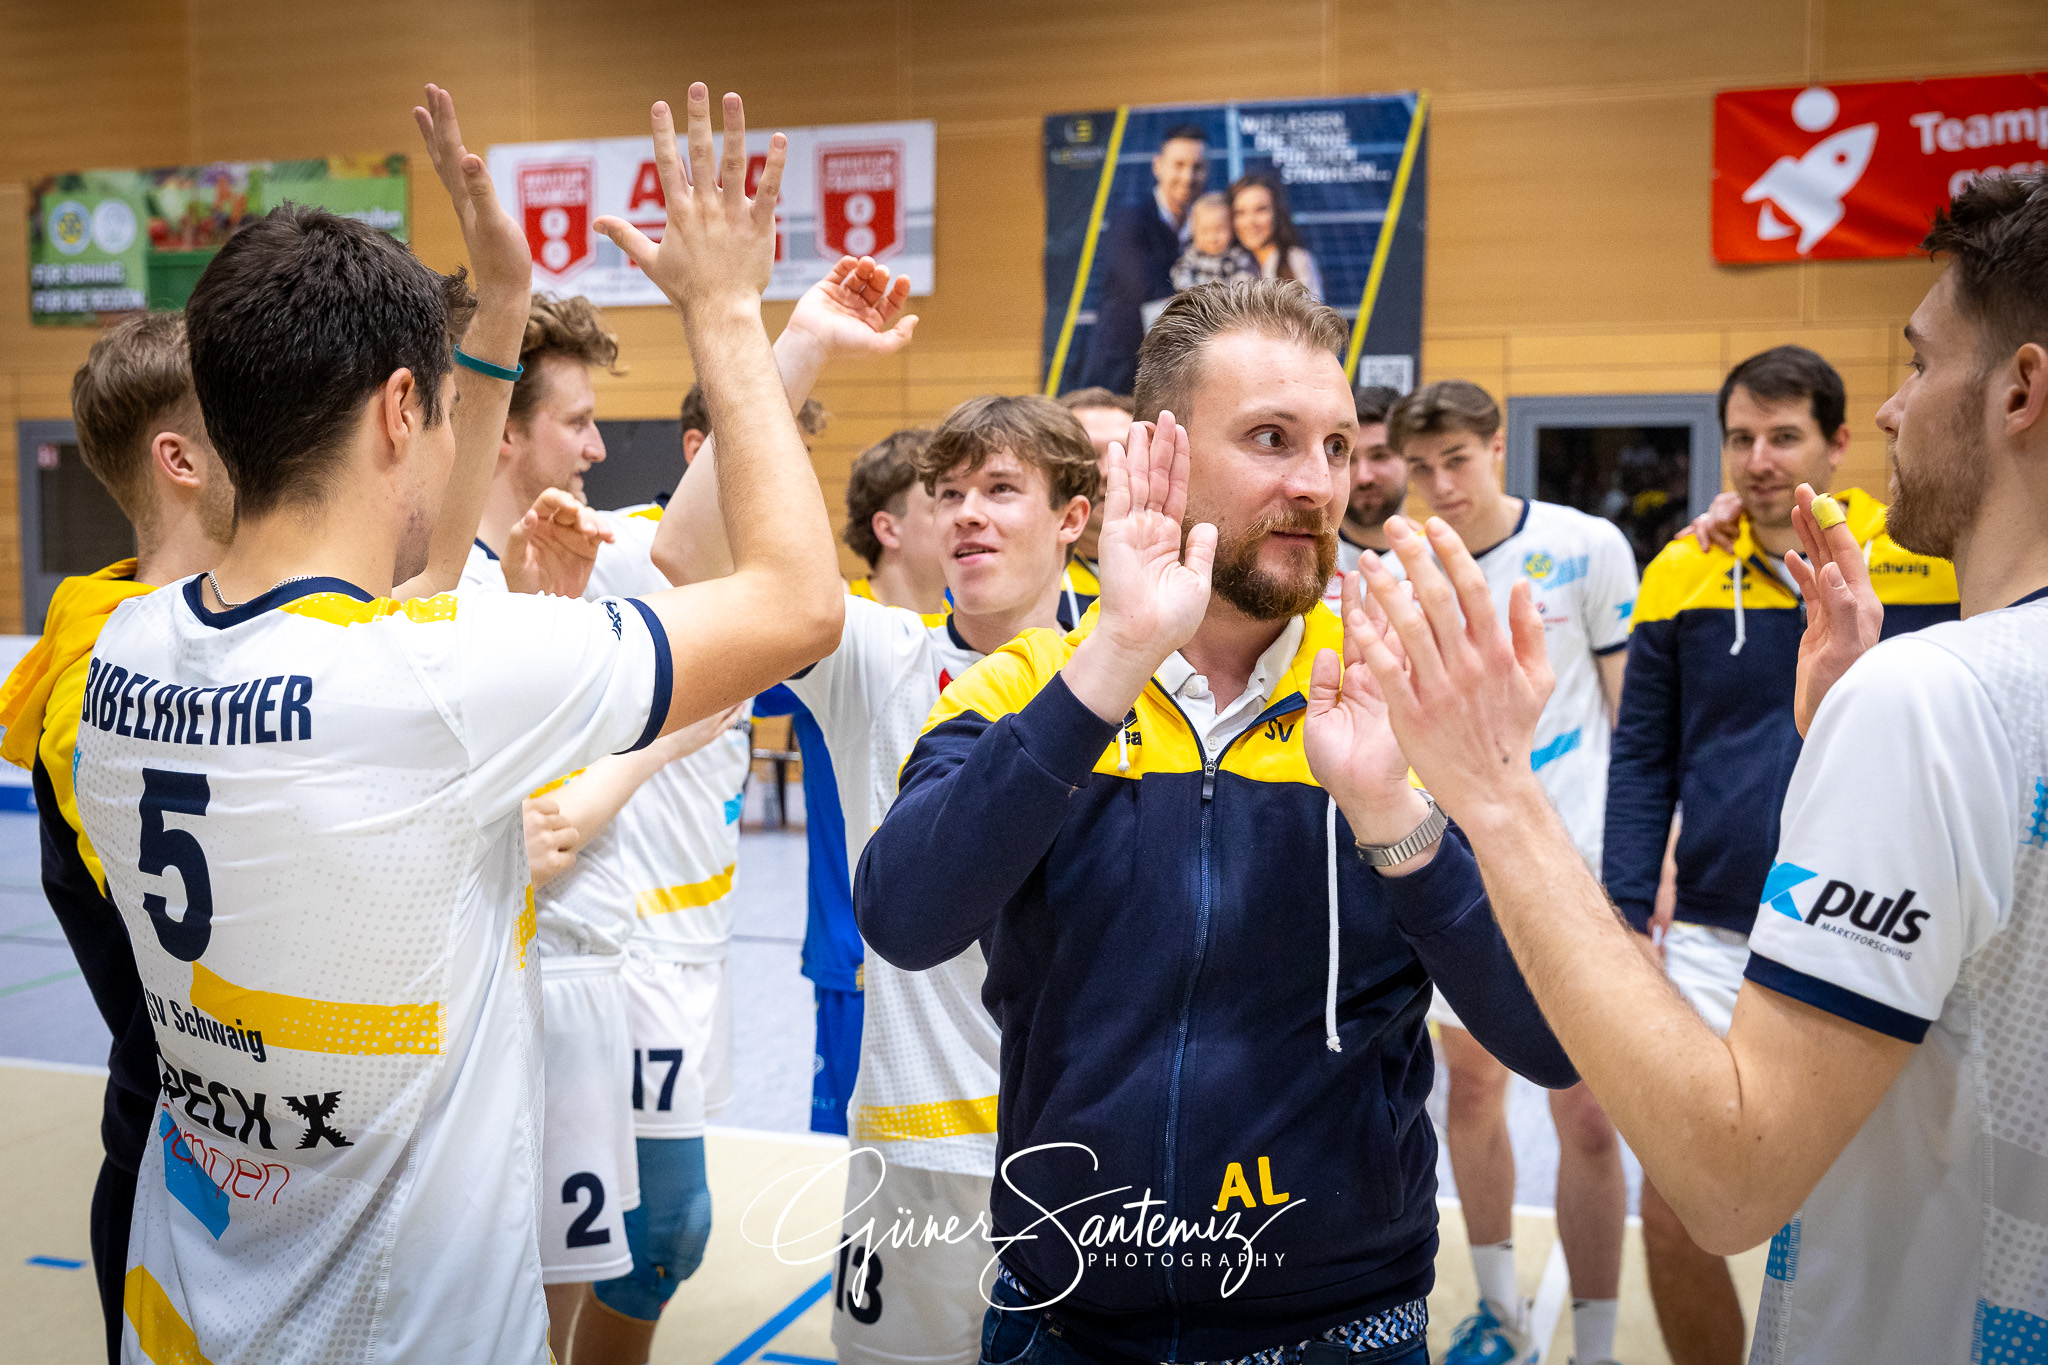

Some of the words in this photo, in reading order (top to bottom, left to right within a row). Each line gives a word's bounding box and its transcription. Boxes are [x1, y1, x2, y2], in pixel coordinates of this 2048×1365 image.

[81, 657, 312, 745] BIBELRIETHER
[1265, 718, 1295, 742] SV
[138, 768, 213, 962] 5
[1804, 879, 1931, 944] puls
[1820, 922, 1913, 961] MARKTFORSCHUNG
[168, 999, 267, 1062] Schwaig
[632, 1047, 684, 1111] 17
[562, 1170, 611, 1249] 2
[1217, 1156, 1290, 1212] AL
